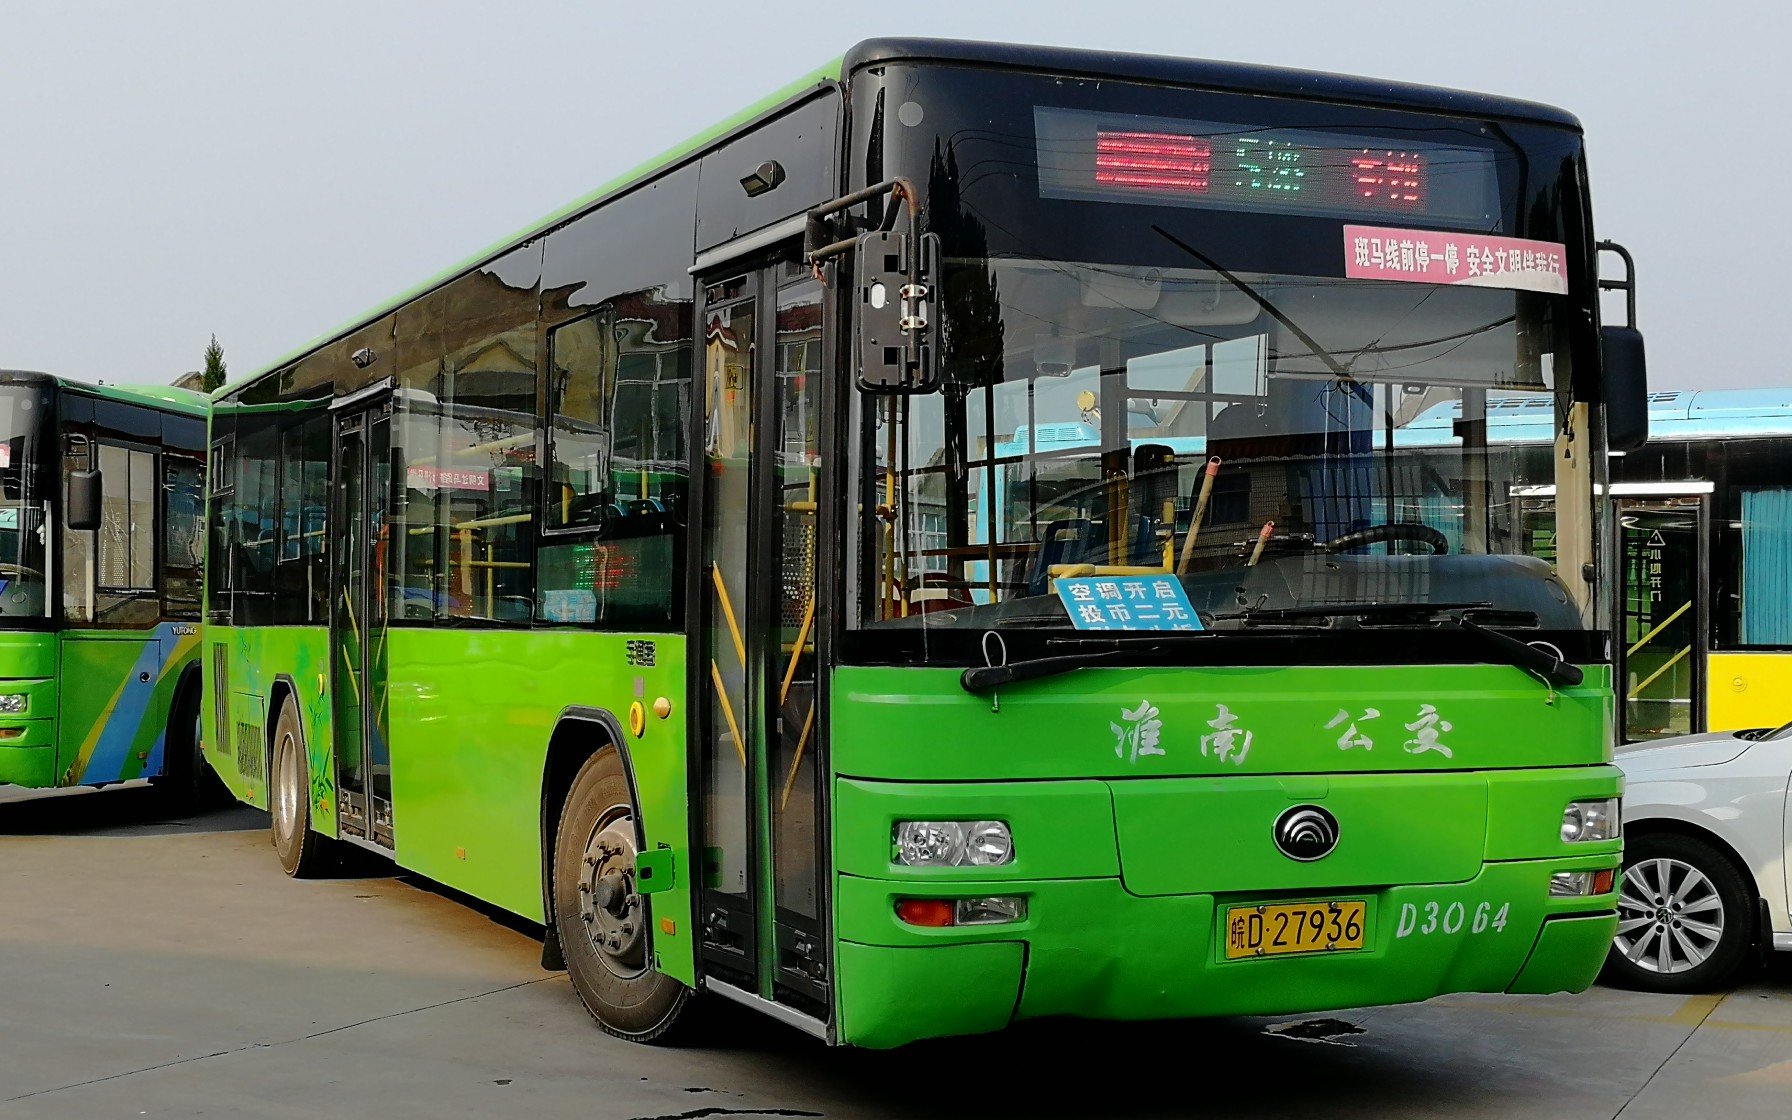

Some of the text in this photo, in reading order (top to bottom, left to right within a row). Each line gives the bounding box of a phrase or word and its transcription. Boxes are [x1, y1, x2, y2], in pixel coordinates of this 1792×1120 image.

[1354, 236, 1460, 275] 斑马线前停一停
[1067, 580, 1177, 602] 空调开启
[1077, 602, 1189, 624] 投币二元
[171, 626, 197, 636] YUTONG
